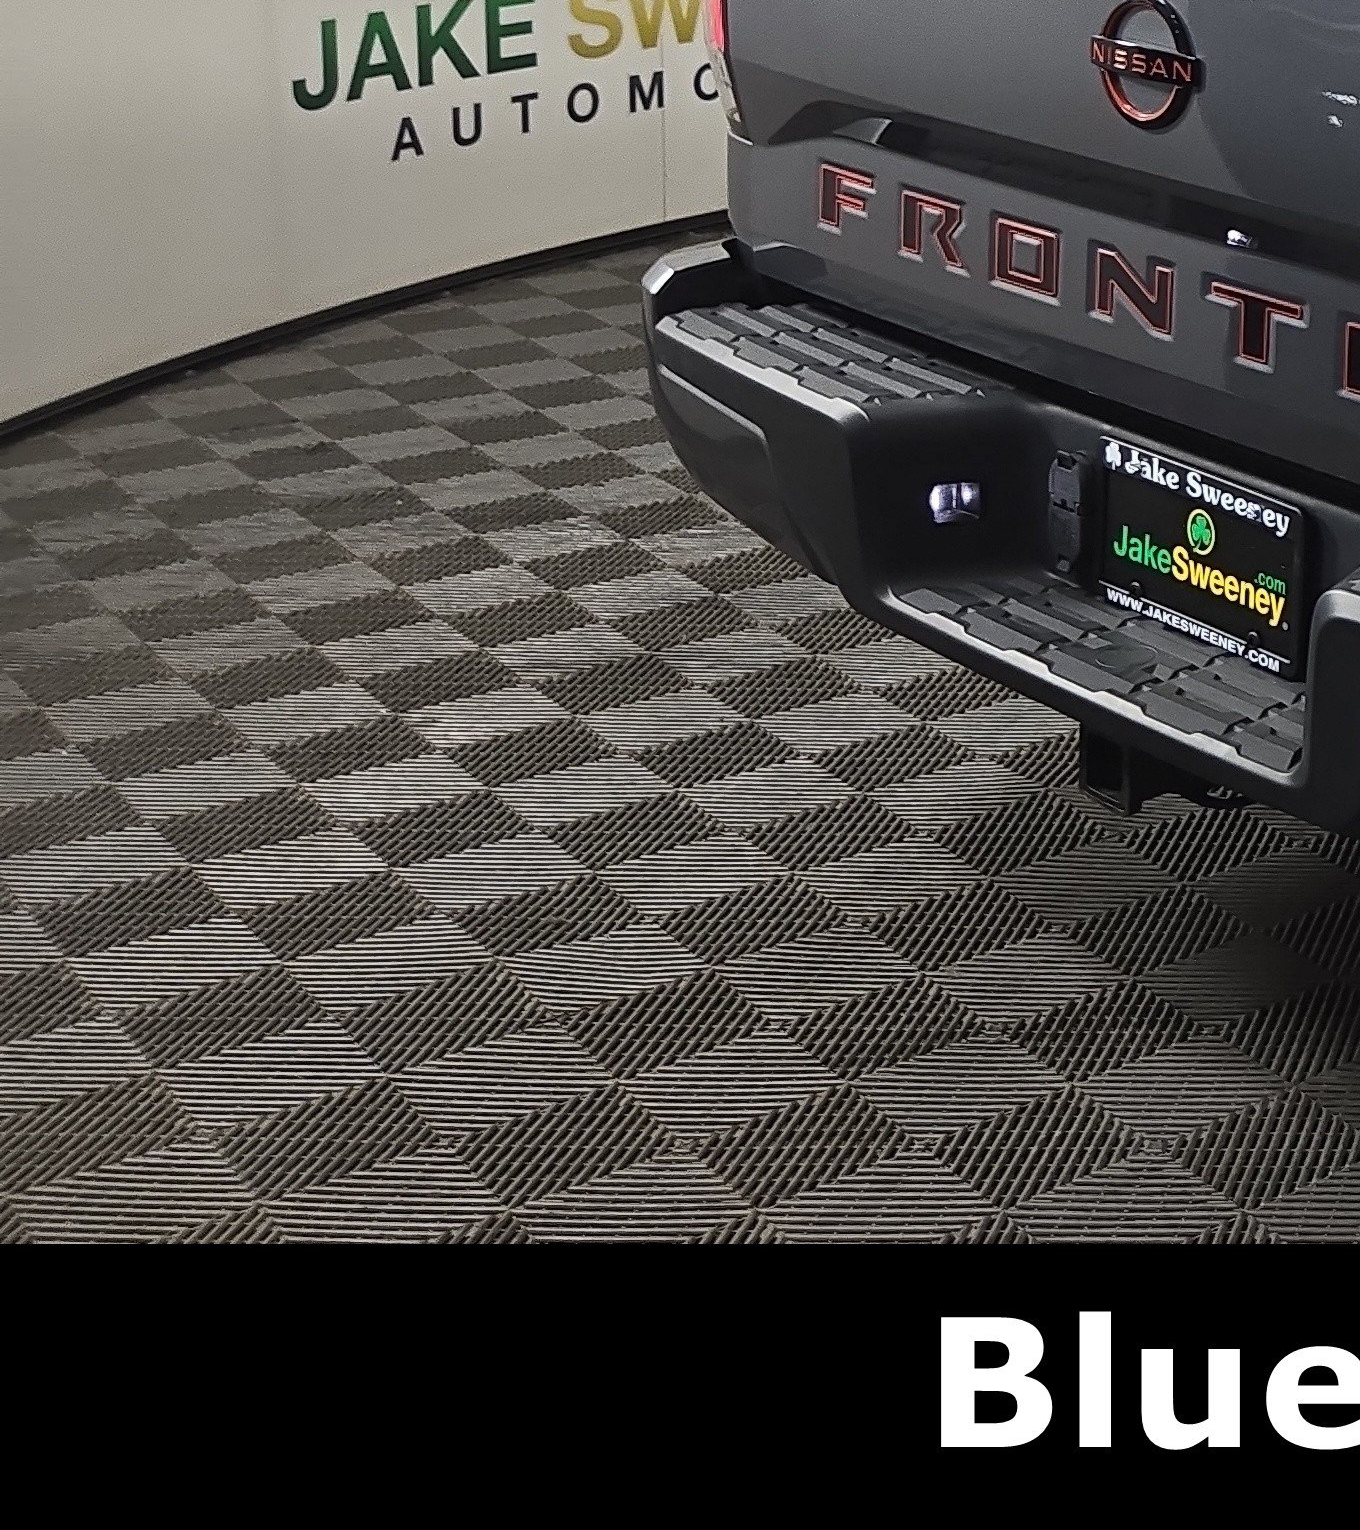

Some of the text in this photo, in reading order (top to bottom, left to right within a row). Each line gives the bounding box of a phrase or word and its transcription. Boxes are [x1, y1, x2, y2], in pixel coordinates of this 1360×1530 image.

[1092, 40, 1191, 82] NISSAN
[391, 63, 719, 161] AUTOMO
[1125, 450, 1290, 537] Jake Sweeney
[1106, 588, 1280, 672] WWW.JAKESWEENEY.COM
